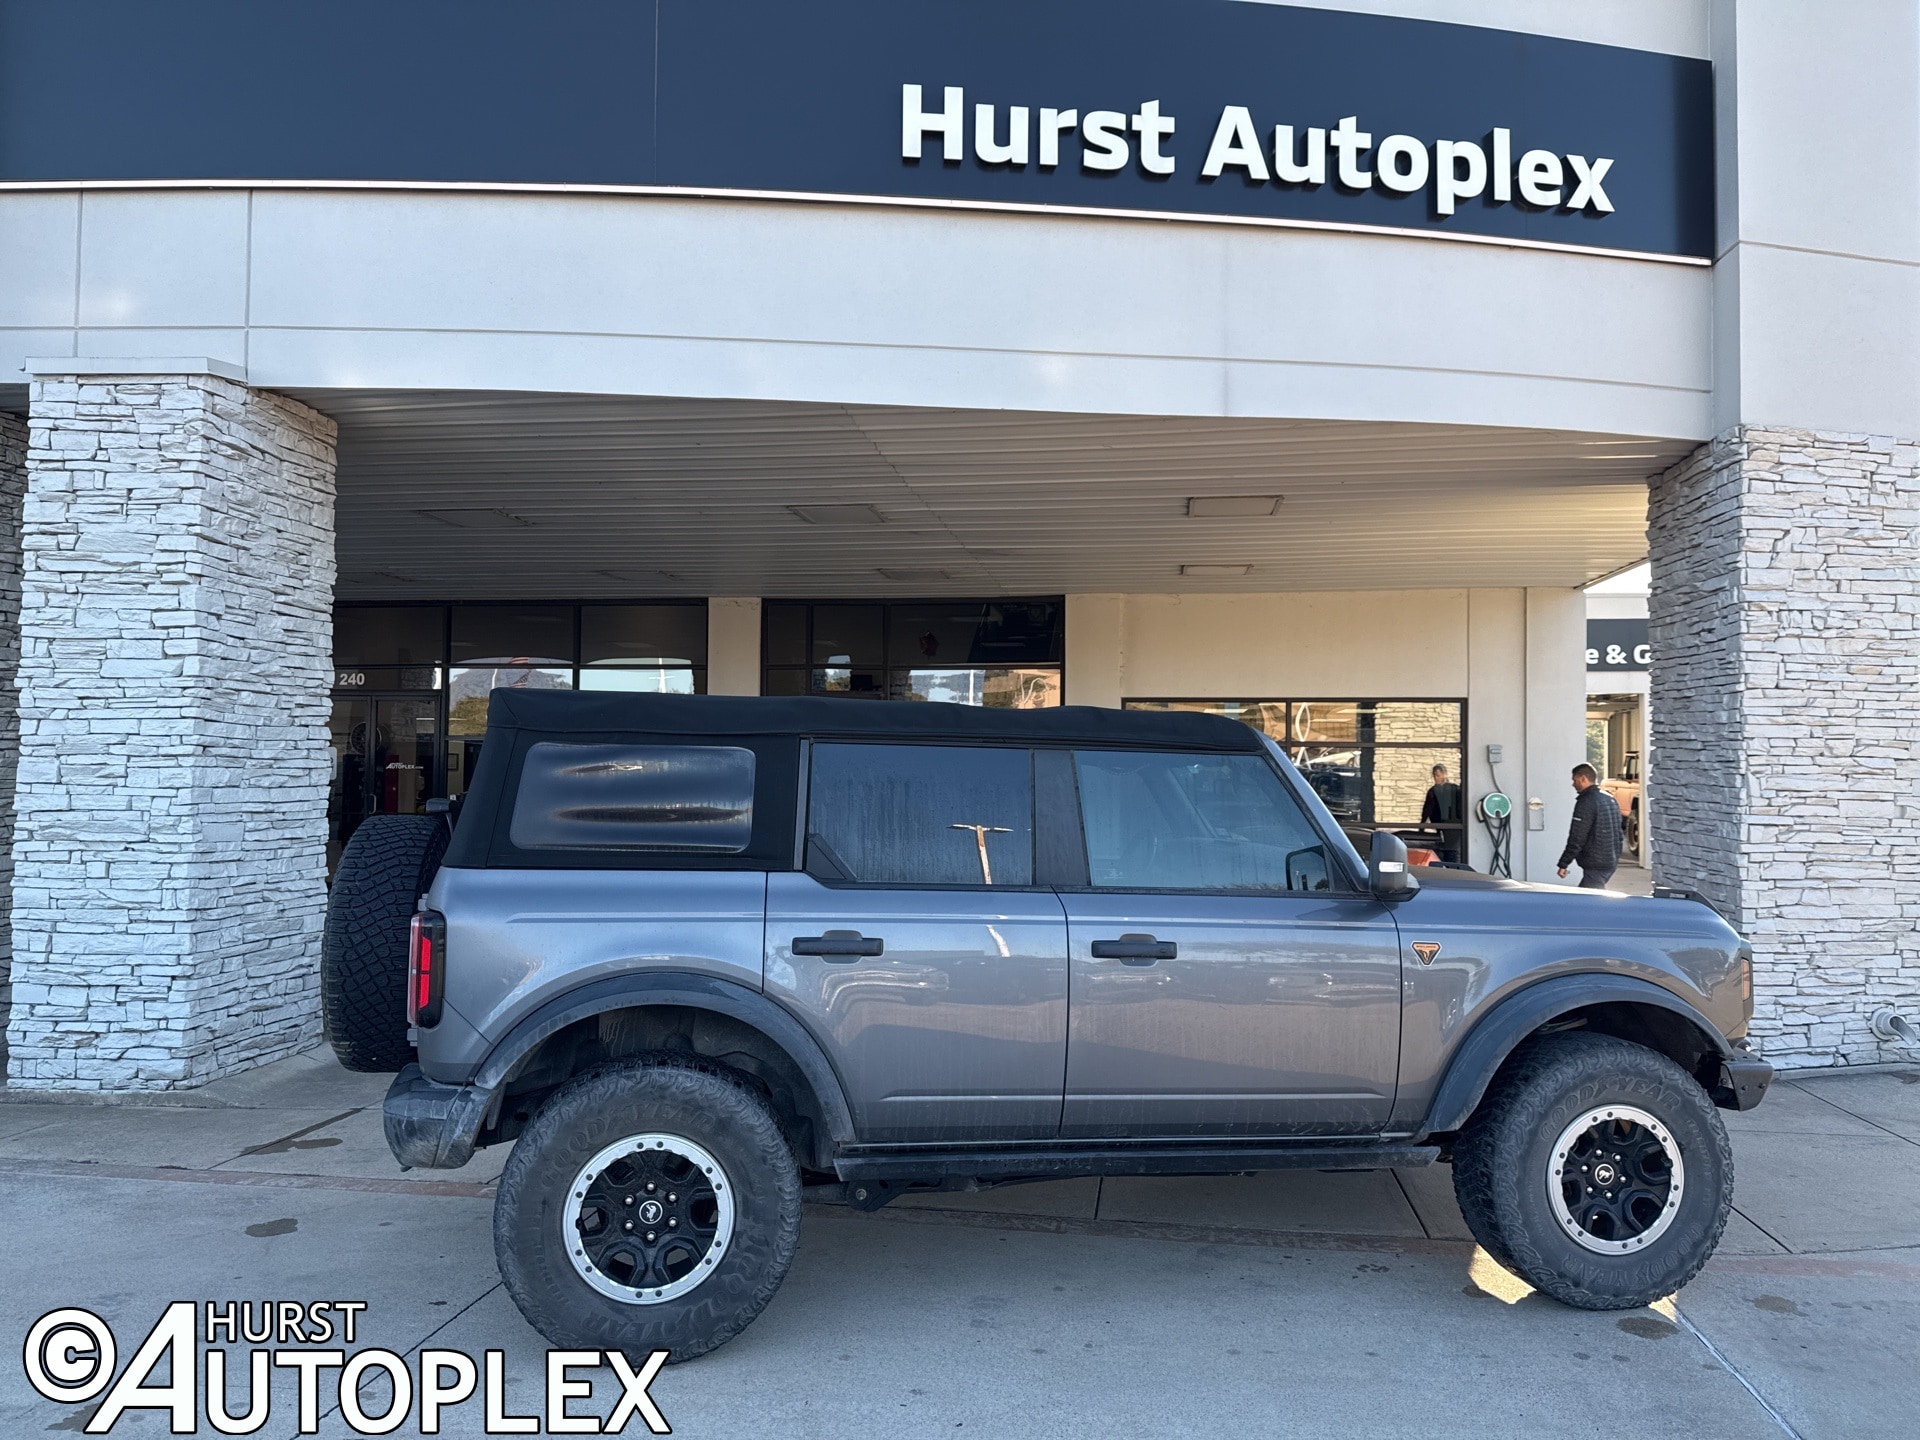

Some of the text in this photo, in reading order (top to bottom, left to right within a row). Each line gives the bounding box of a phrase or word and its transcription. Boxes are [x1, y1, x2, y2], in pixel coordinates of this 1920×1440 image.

[901, 83, 1616, 215] Hurst Autoplex
[1605, 644, 1628, 665] &
[339, 672, 365, 686] 240
